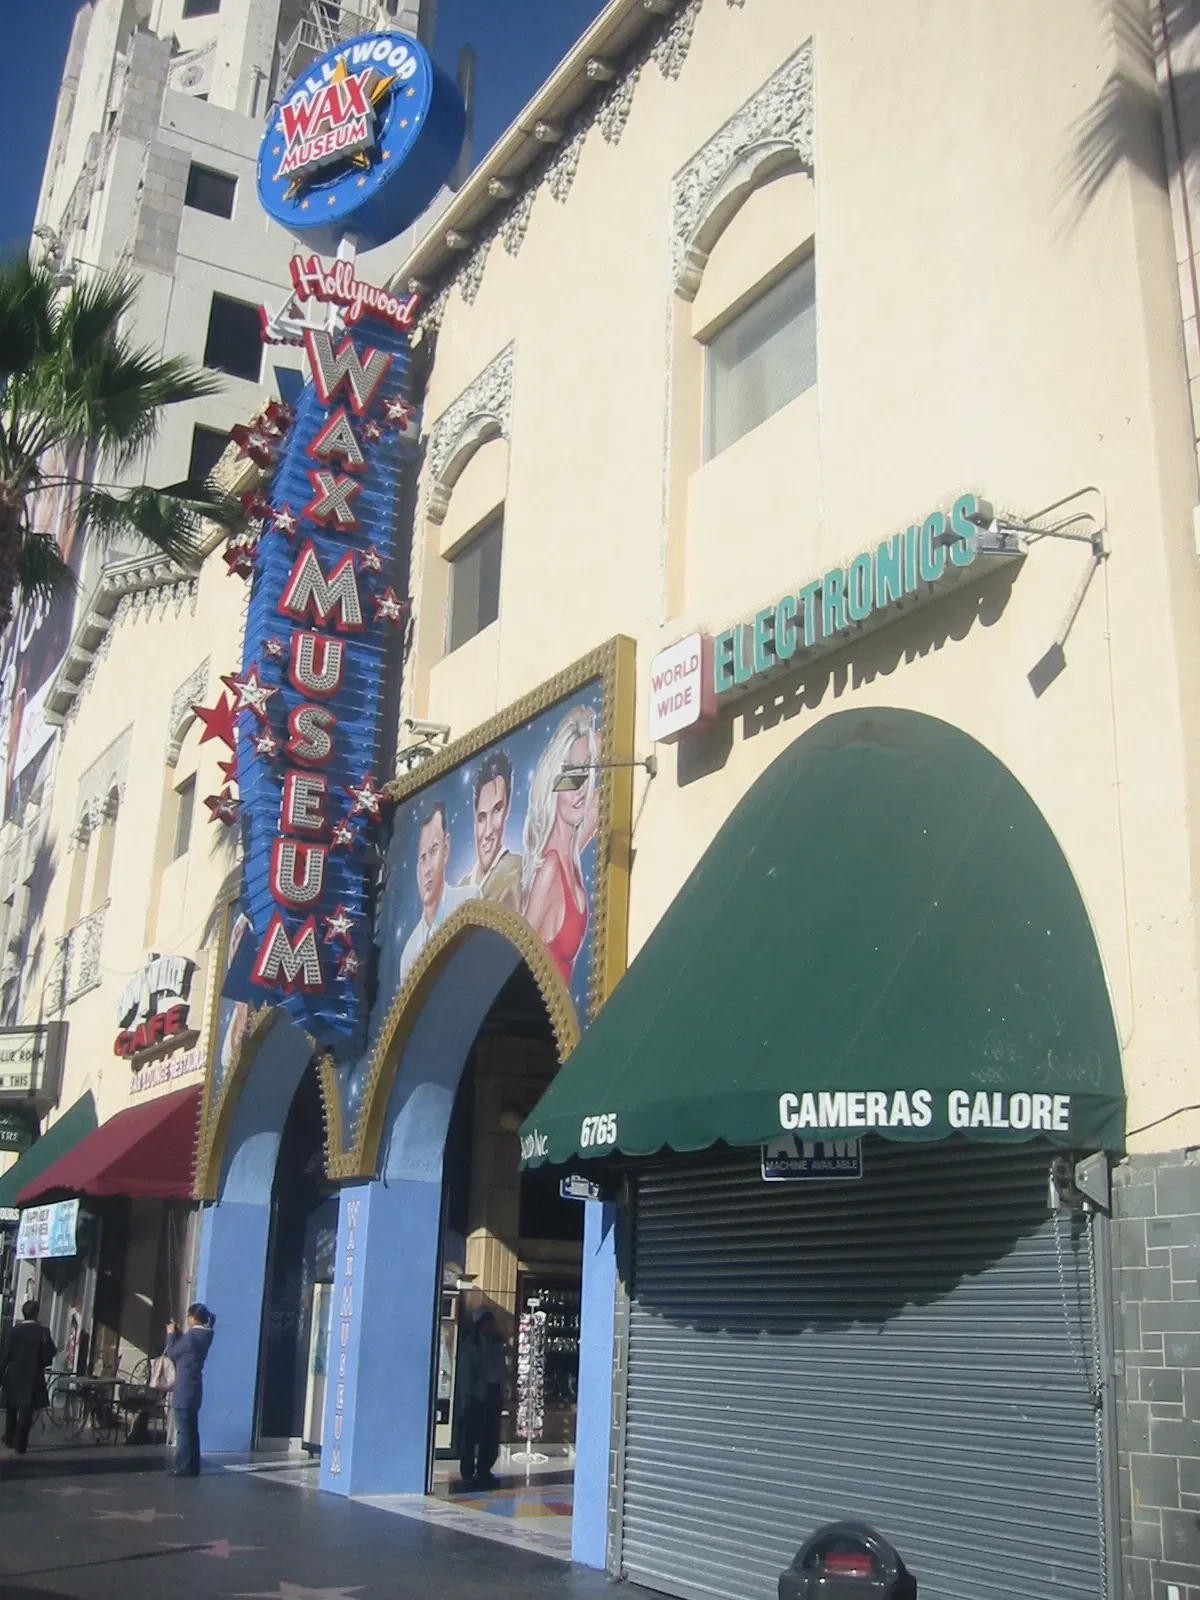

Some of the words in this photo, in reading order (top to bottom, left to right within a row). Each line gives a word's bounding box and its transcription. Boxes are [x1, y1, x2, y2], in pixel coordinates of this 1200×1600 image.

[276, 40, 418, 130] OLLYWOOD
[280, 67, 374, 150] WAX
[277, 118, 368, 176] MUSEUM
[290, 254, 420, 330] Hollywood
[303, 328, 392, 531] WAX
[713, 493, 978, 694] ELECTRONICS
[651, 654, 699, 693] WORLD
[657, 687, 693, 719] WIDE
[250, 537, 365, 994] MUSEUM
[114, 1003, 188, 1056] CAFE
[580, 1112, 618, 1148] 6765
[778, 1089, 932, 1130] CAMERAS
[947, 1090, 1071, 1131] GALORE
[765, 1160, 808, 1170] MACHINE
[811, 1159, 859, 1169] AVAILABLE
